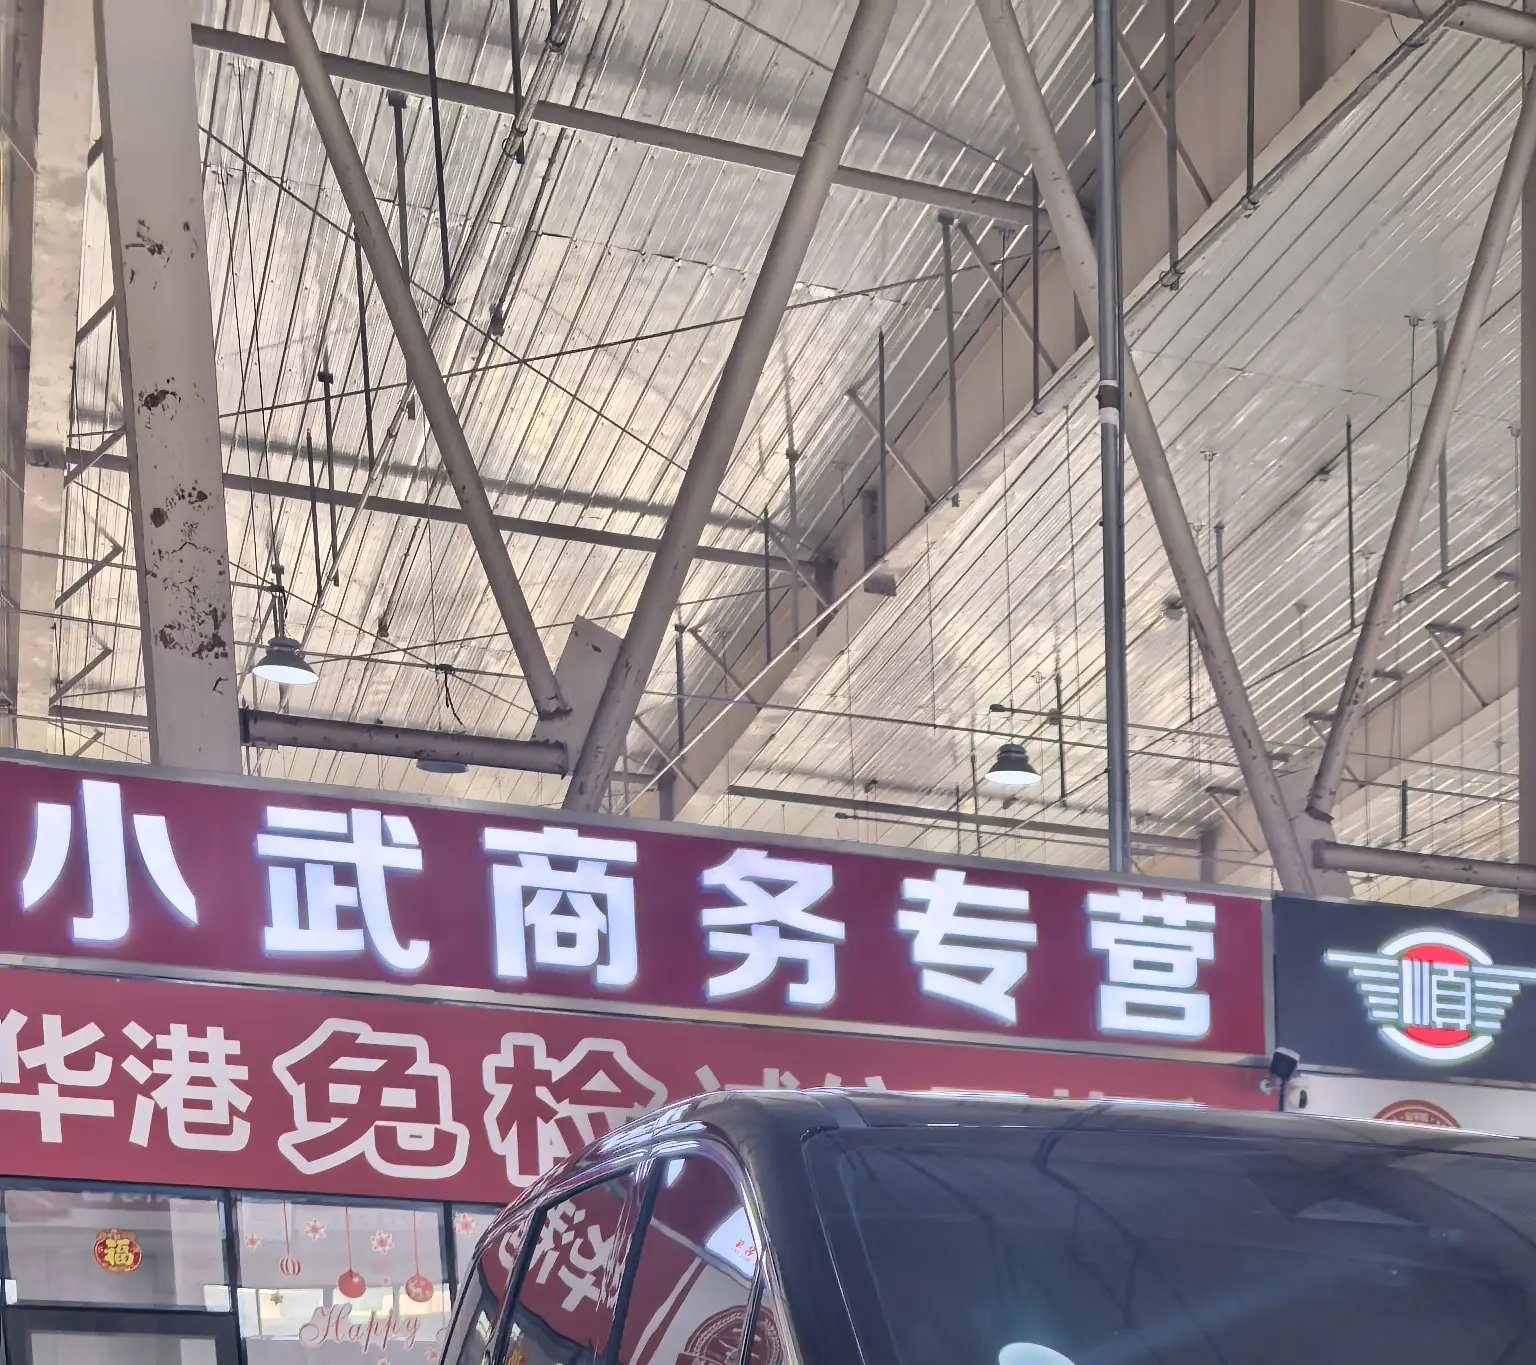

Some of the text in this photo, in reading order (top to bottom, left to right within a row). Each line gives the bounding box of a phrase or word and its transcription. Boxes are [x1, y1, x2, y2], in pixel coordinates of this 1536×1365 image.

[20, 778, 1216, 1038] 小武商务专营
[103, 1238, 135, 1266] 福
[300, 1303, 421, 1354] Happy
